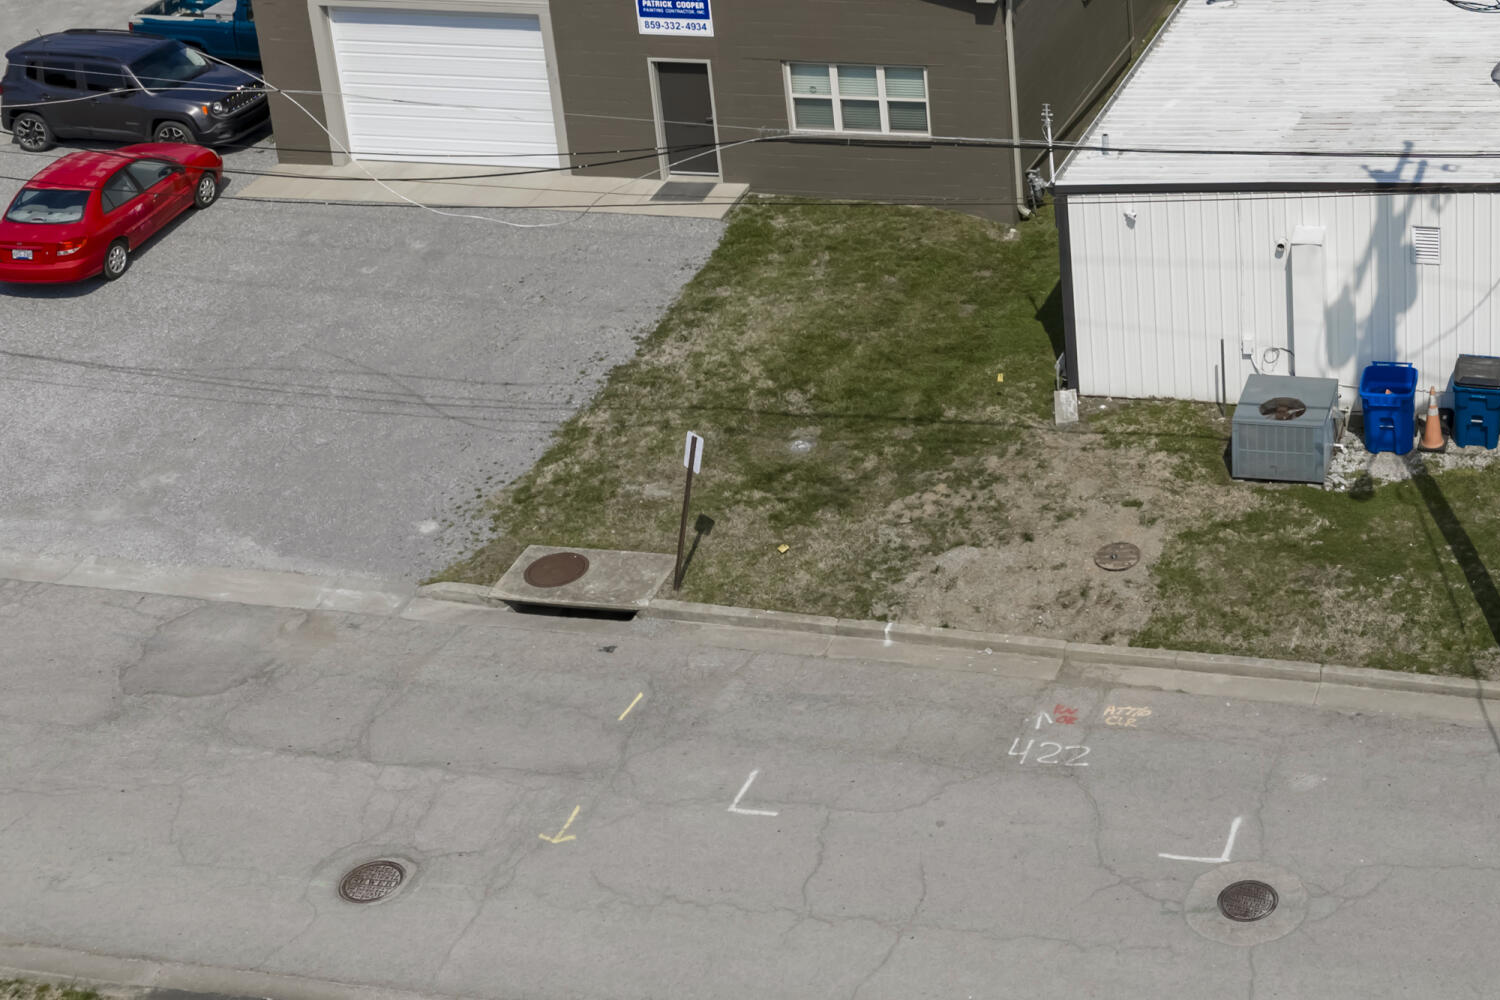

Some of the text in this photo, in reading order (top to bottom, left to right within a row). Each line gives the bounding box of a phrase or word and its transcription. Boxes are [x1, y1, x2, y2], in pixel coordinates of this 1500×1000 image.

[642, 0, 705, 9] PATRICK COOPER
[644, 20, 707, 30] 859-332-4934
[1008, 737, 1091, 766] 422
